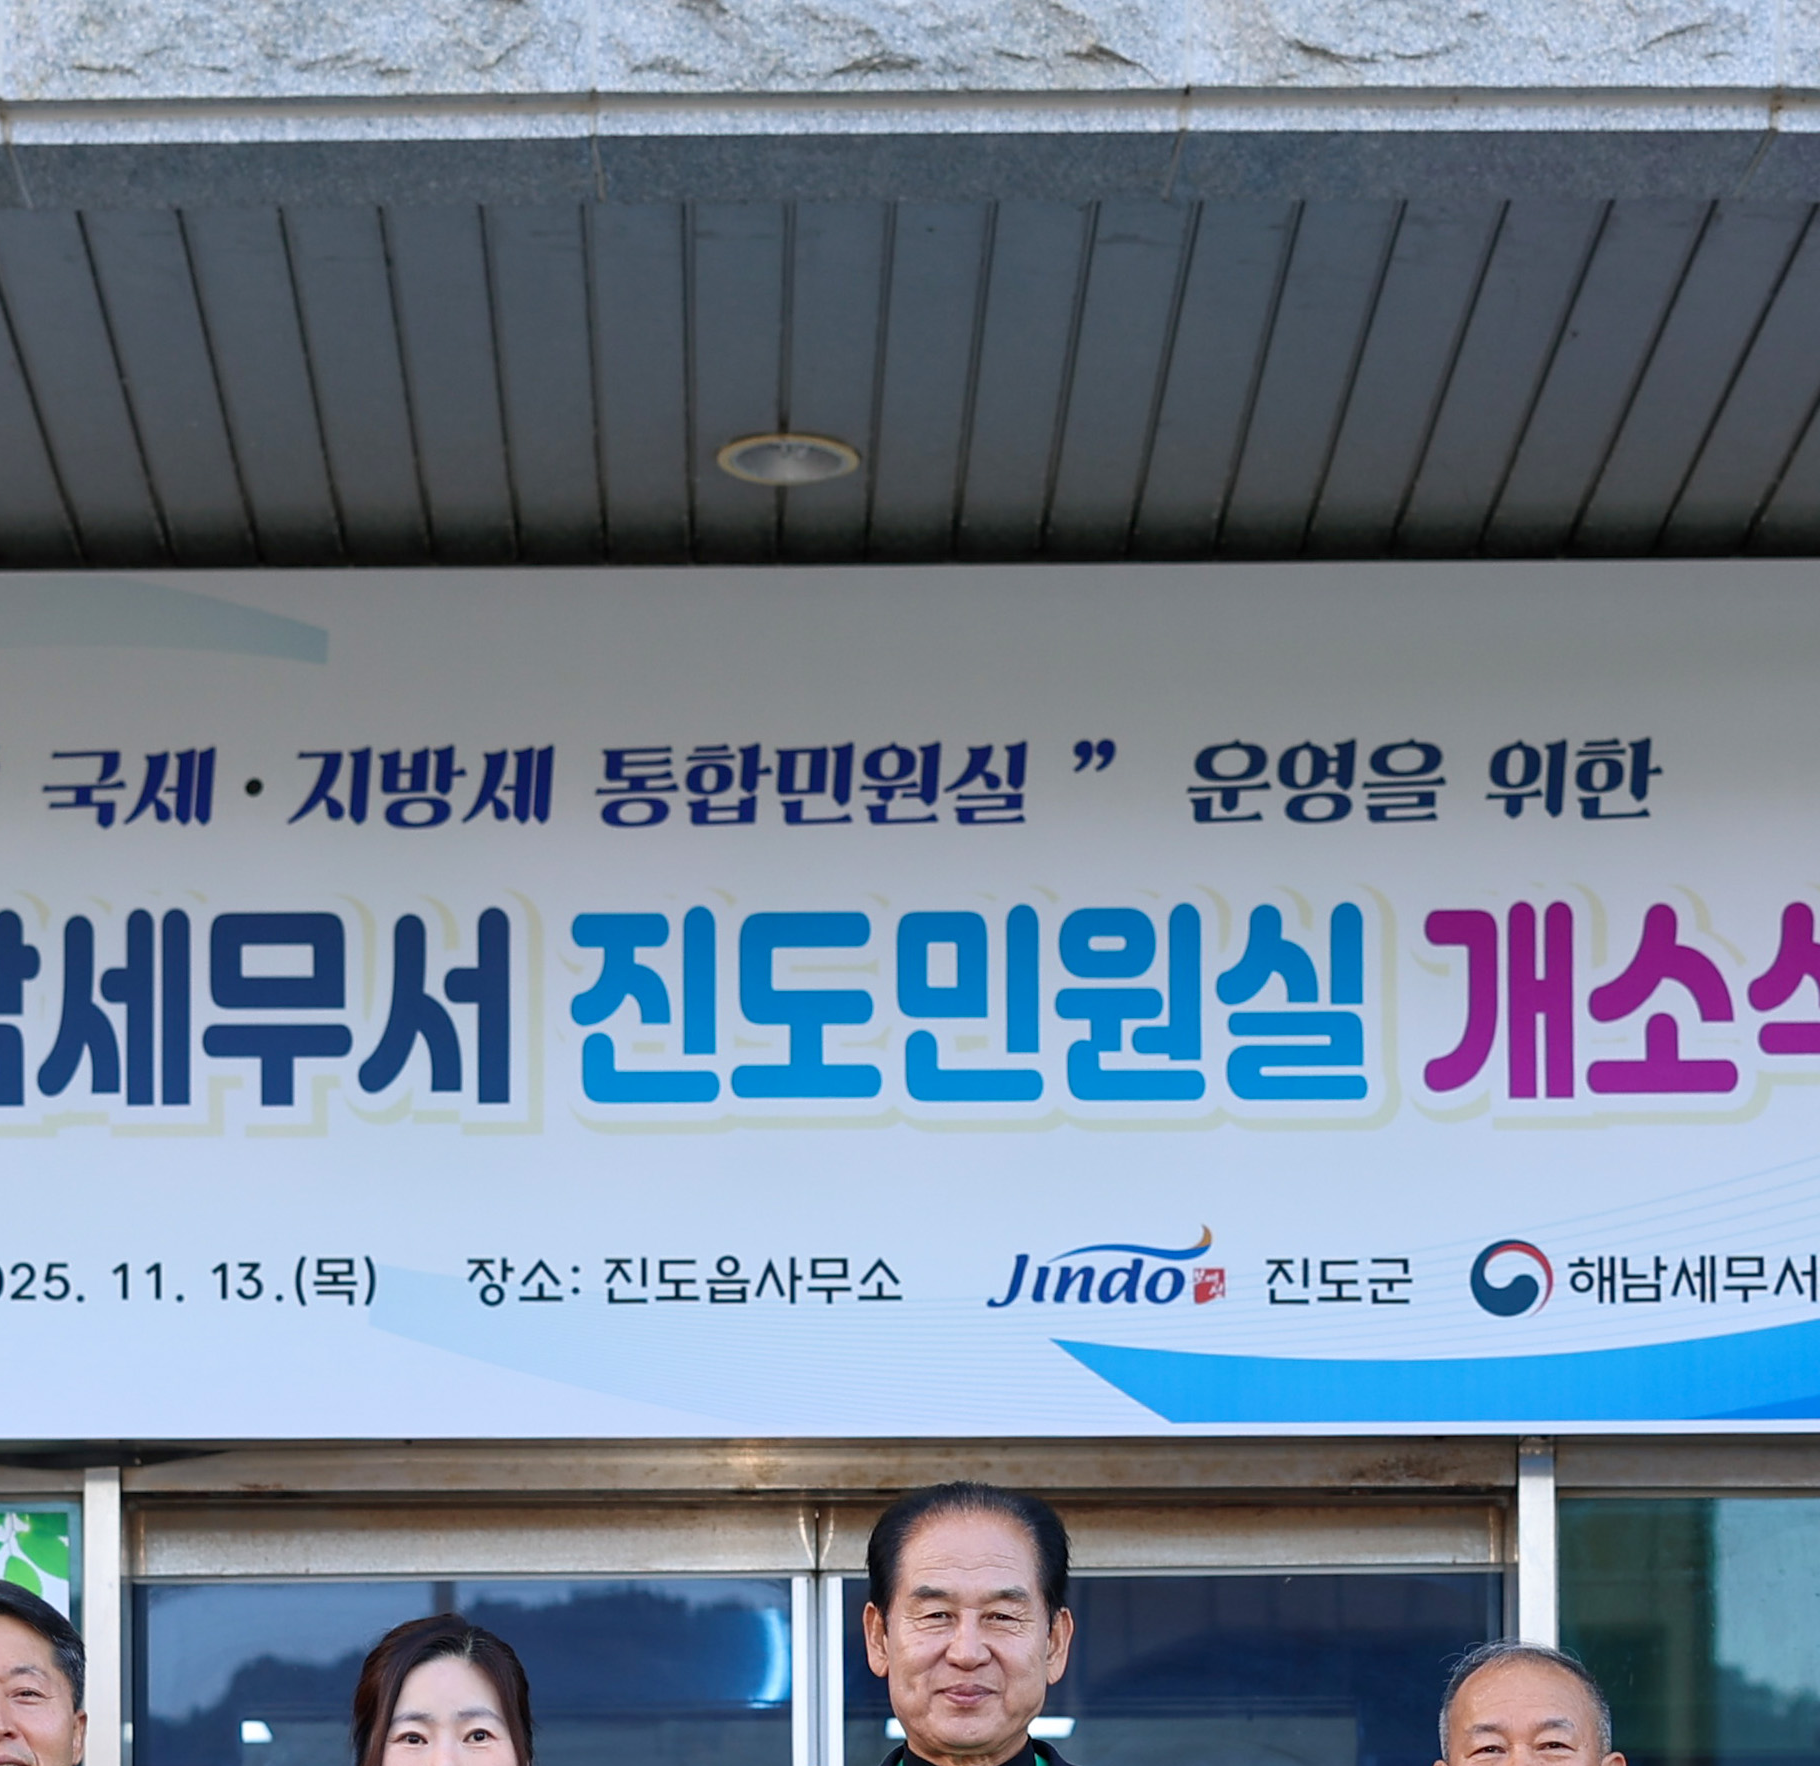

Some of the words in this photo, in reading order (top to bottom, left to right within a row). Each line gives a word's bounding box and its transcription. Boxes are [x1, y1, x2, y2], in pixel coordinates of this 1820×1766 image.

[595, 740, 1028, 829] 통합민원실
[1186, 738, 1447, 825] 운영을
[1486, 735, 1664, 820] 위한
[570, 901, 1368, 1104] 진도민원실
[466, 1255, 580, 1307] 장소:
[603, 1254, 904, 1308] 진도읍사무소
[987, 1252, 1185, 1309] Jindo
[1265, 1257, 1413, 1305] 진도군
[1569, 1253, 1819, 1305] 해남세무서
